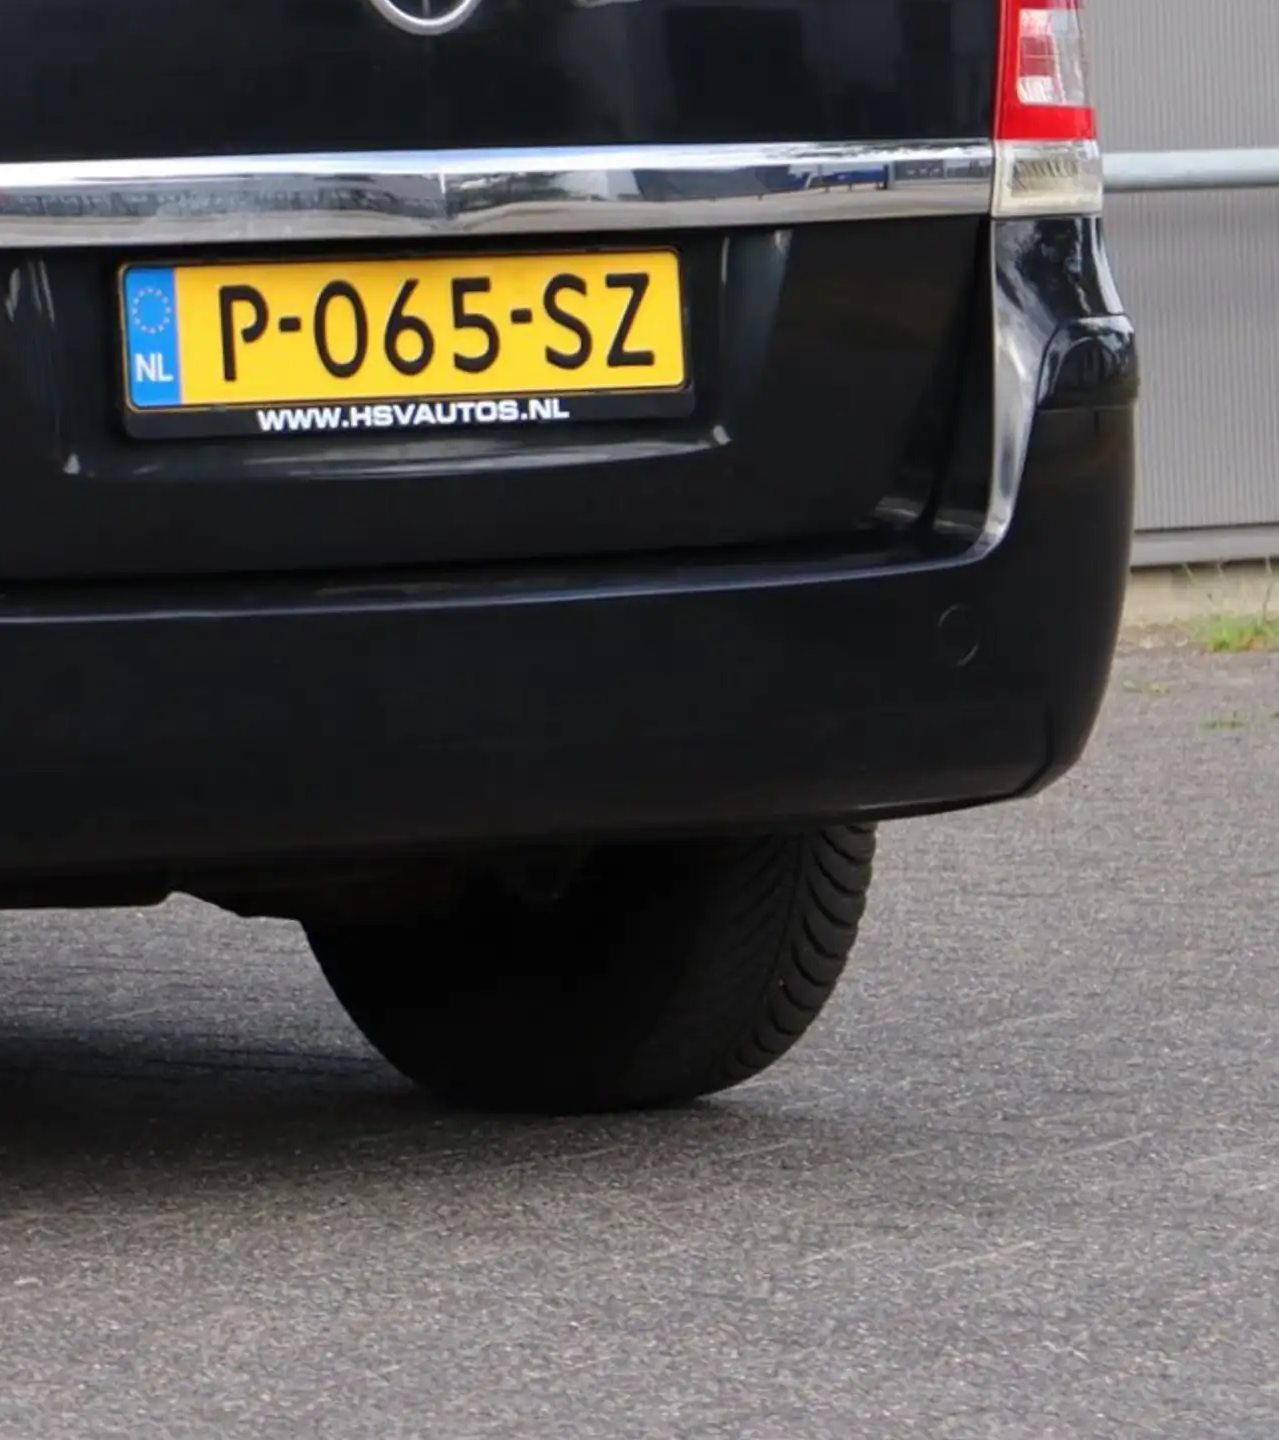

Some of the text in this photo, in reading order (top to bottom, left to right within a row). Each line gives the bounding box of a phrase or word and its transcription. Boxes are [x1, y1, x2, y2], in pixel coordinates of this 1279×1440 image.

[218, 272, 655, 382] P-065-SZ
[135, 354, 173, 383] NL
[257, 397, 569, 432] WWW.HSVAUTOS.NL
